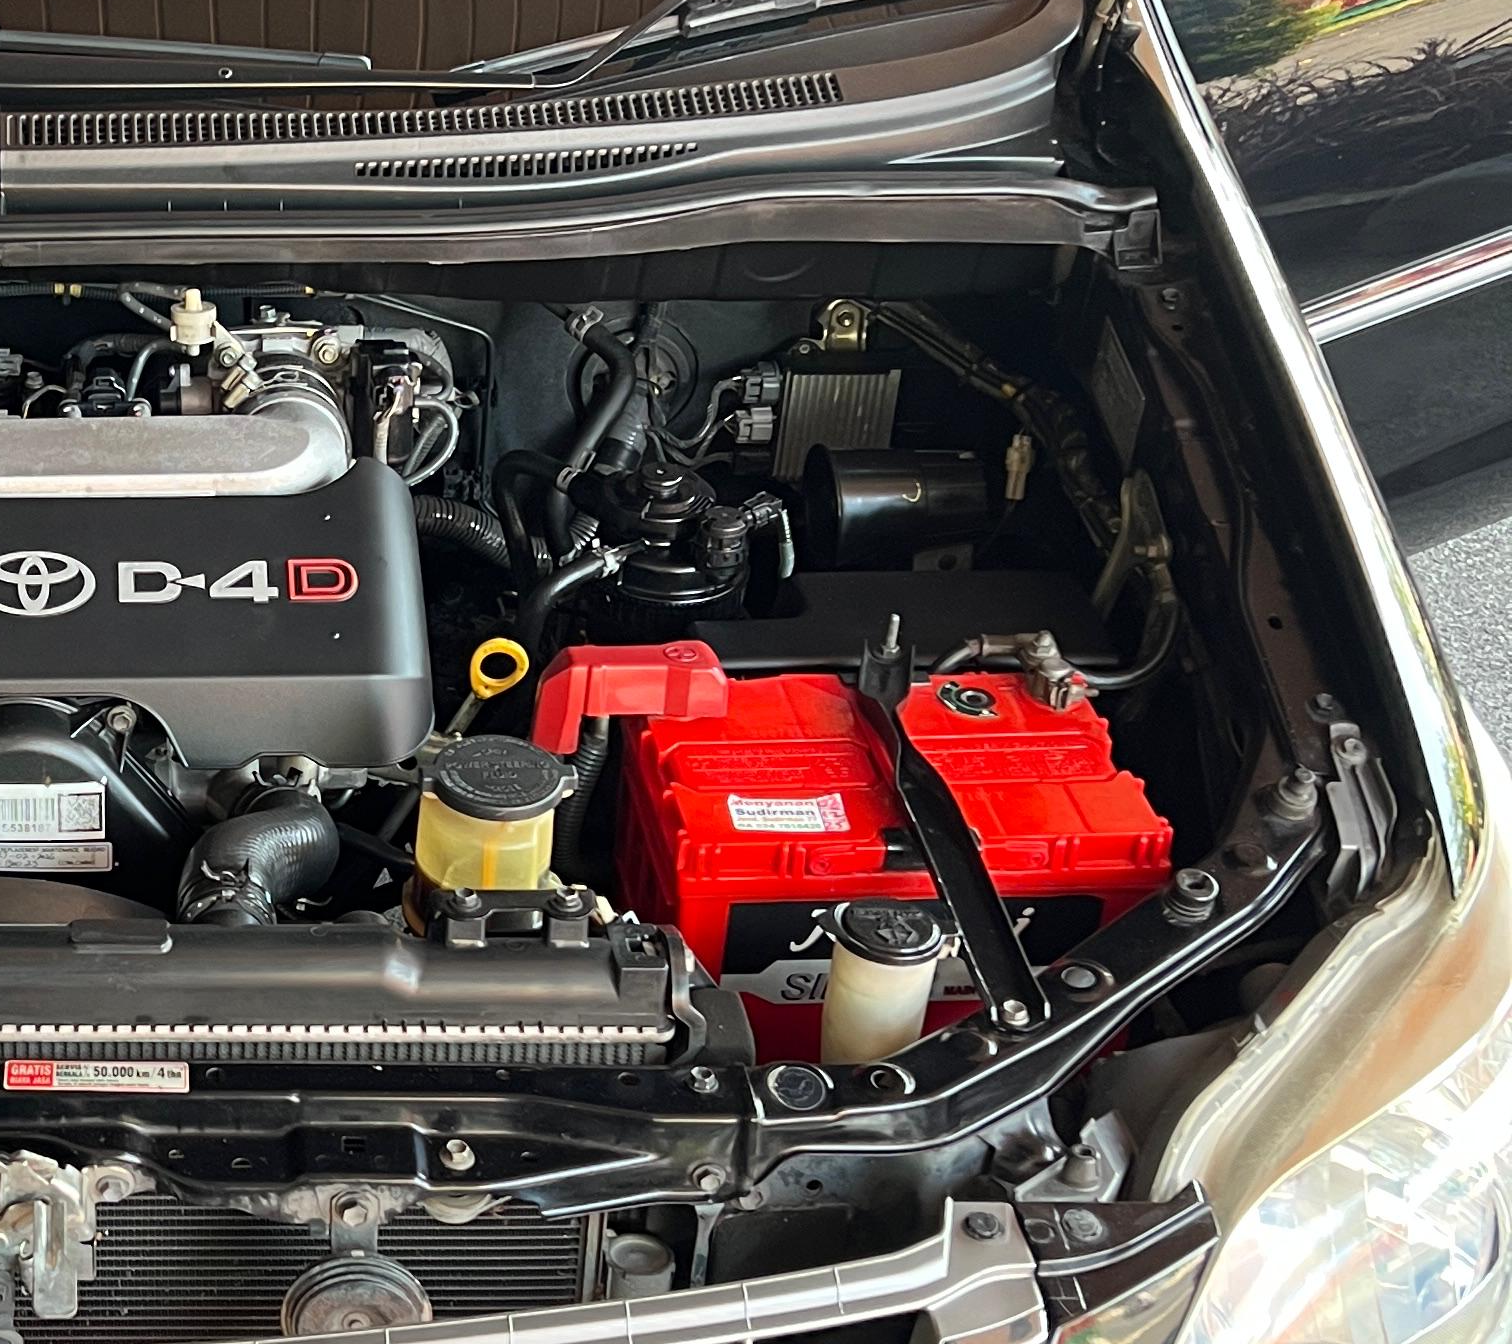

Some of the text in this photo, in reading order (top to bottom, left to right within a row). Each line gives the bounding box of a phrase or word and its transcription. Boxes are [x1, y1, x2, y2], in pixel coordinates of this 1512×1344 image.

[118, 558, 360, 604] D-4D
[735, 808, 816, 816] Sudirman
[10, 1064, 52, 1077] GRATIS
[93, 1066, 135, 1078] 50.000
